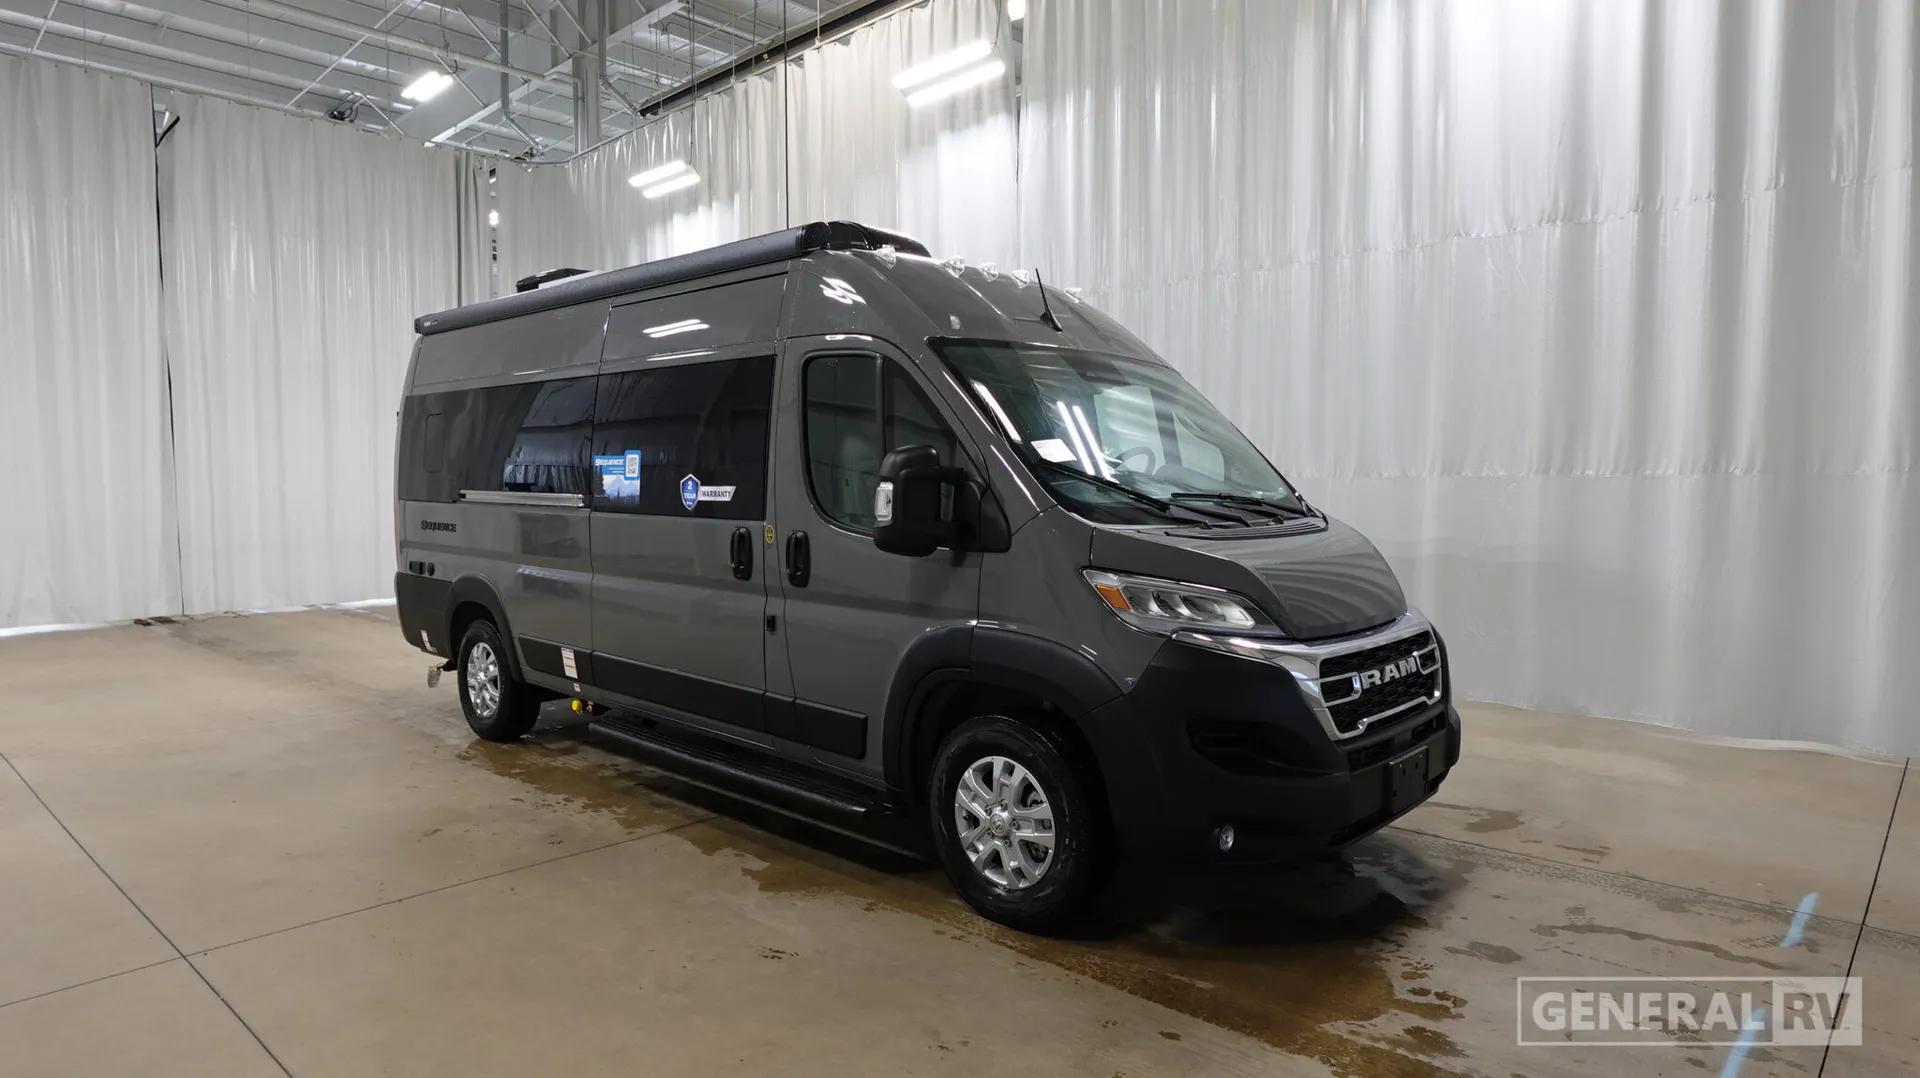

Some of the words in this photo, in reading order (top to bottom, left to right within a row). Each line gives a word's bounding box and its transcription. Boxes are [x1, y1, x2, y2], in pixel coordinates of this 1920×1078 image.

[687, 480, 693, 490] 2
[683, 492, 697, 500] YEAR
[701, 490, 732, 498] WARRANTY
[1360, 656, 1417, 690] RAM
